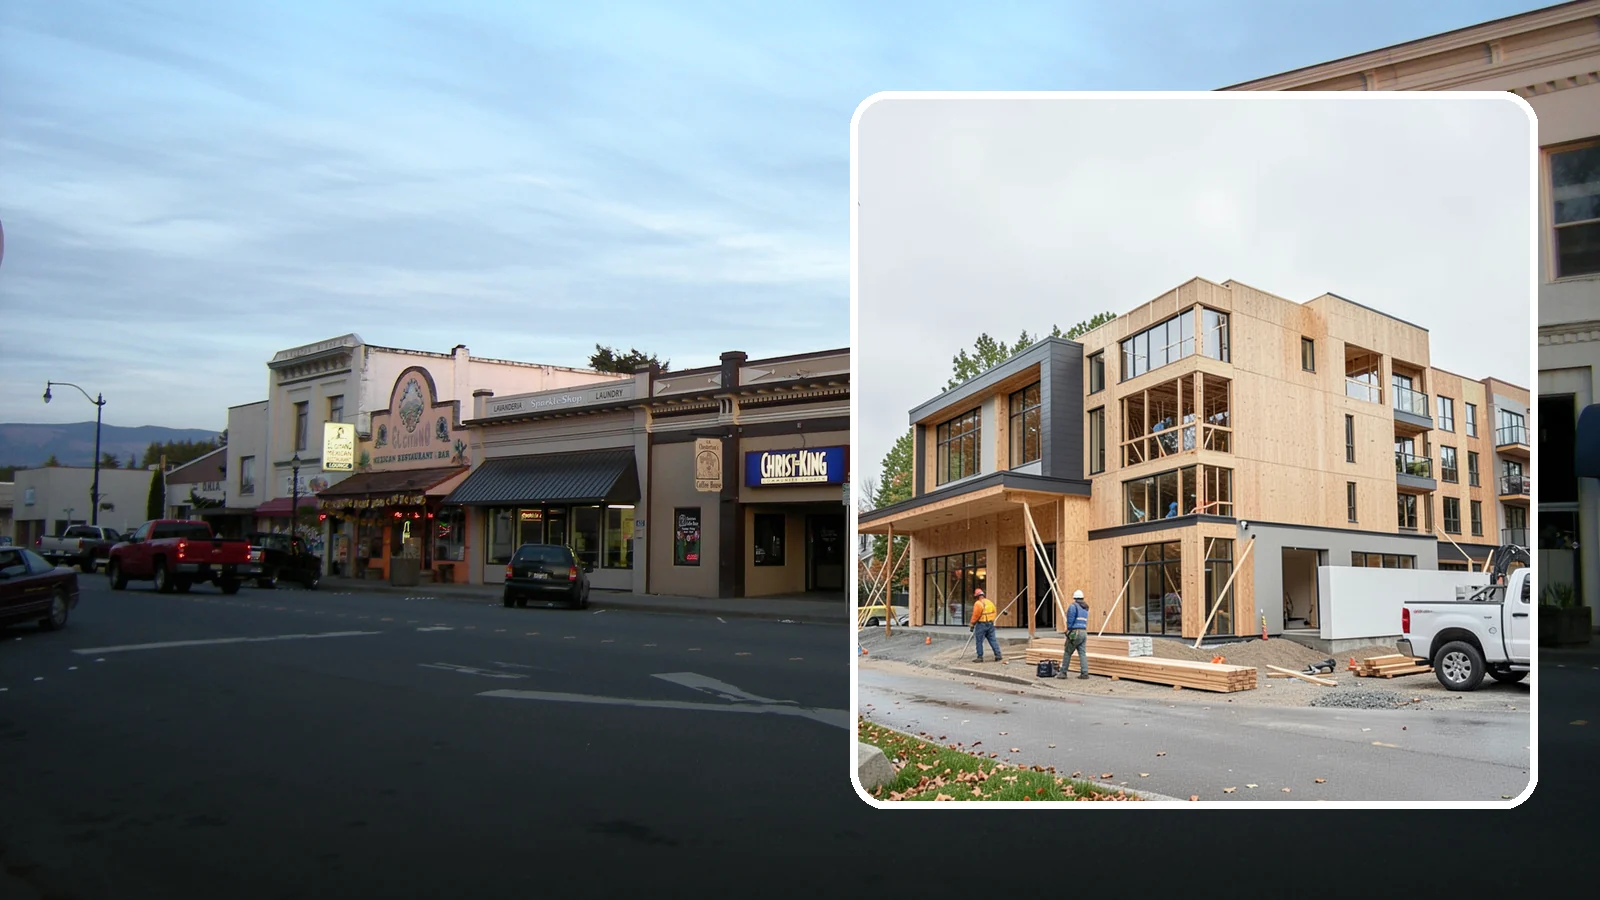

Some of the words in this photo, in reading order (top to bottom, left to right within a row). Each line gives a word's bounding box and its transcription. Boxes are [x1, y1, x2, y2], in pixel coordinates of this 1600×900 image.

[494, 402, 523, 413] LAVANDERIA
[531, 398, 561, 409] Sparkle
[562, 395, 582, 405] Shop
[596, 389, 624, 399] LAUNDRY
[374, 455, 396, 464] MEXICAN
[397, 451, 433, 462] RESTAURANT
[438, 450, 450, 459] BAR
[761, 452, 797, 477] CHRIST
[799, 450, 827, 476] KING
